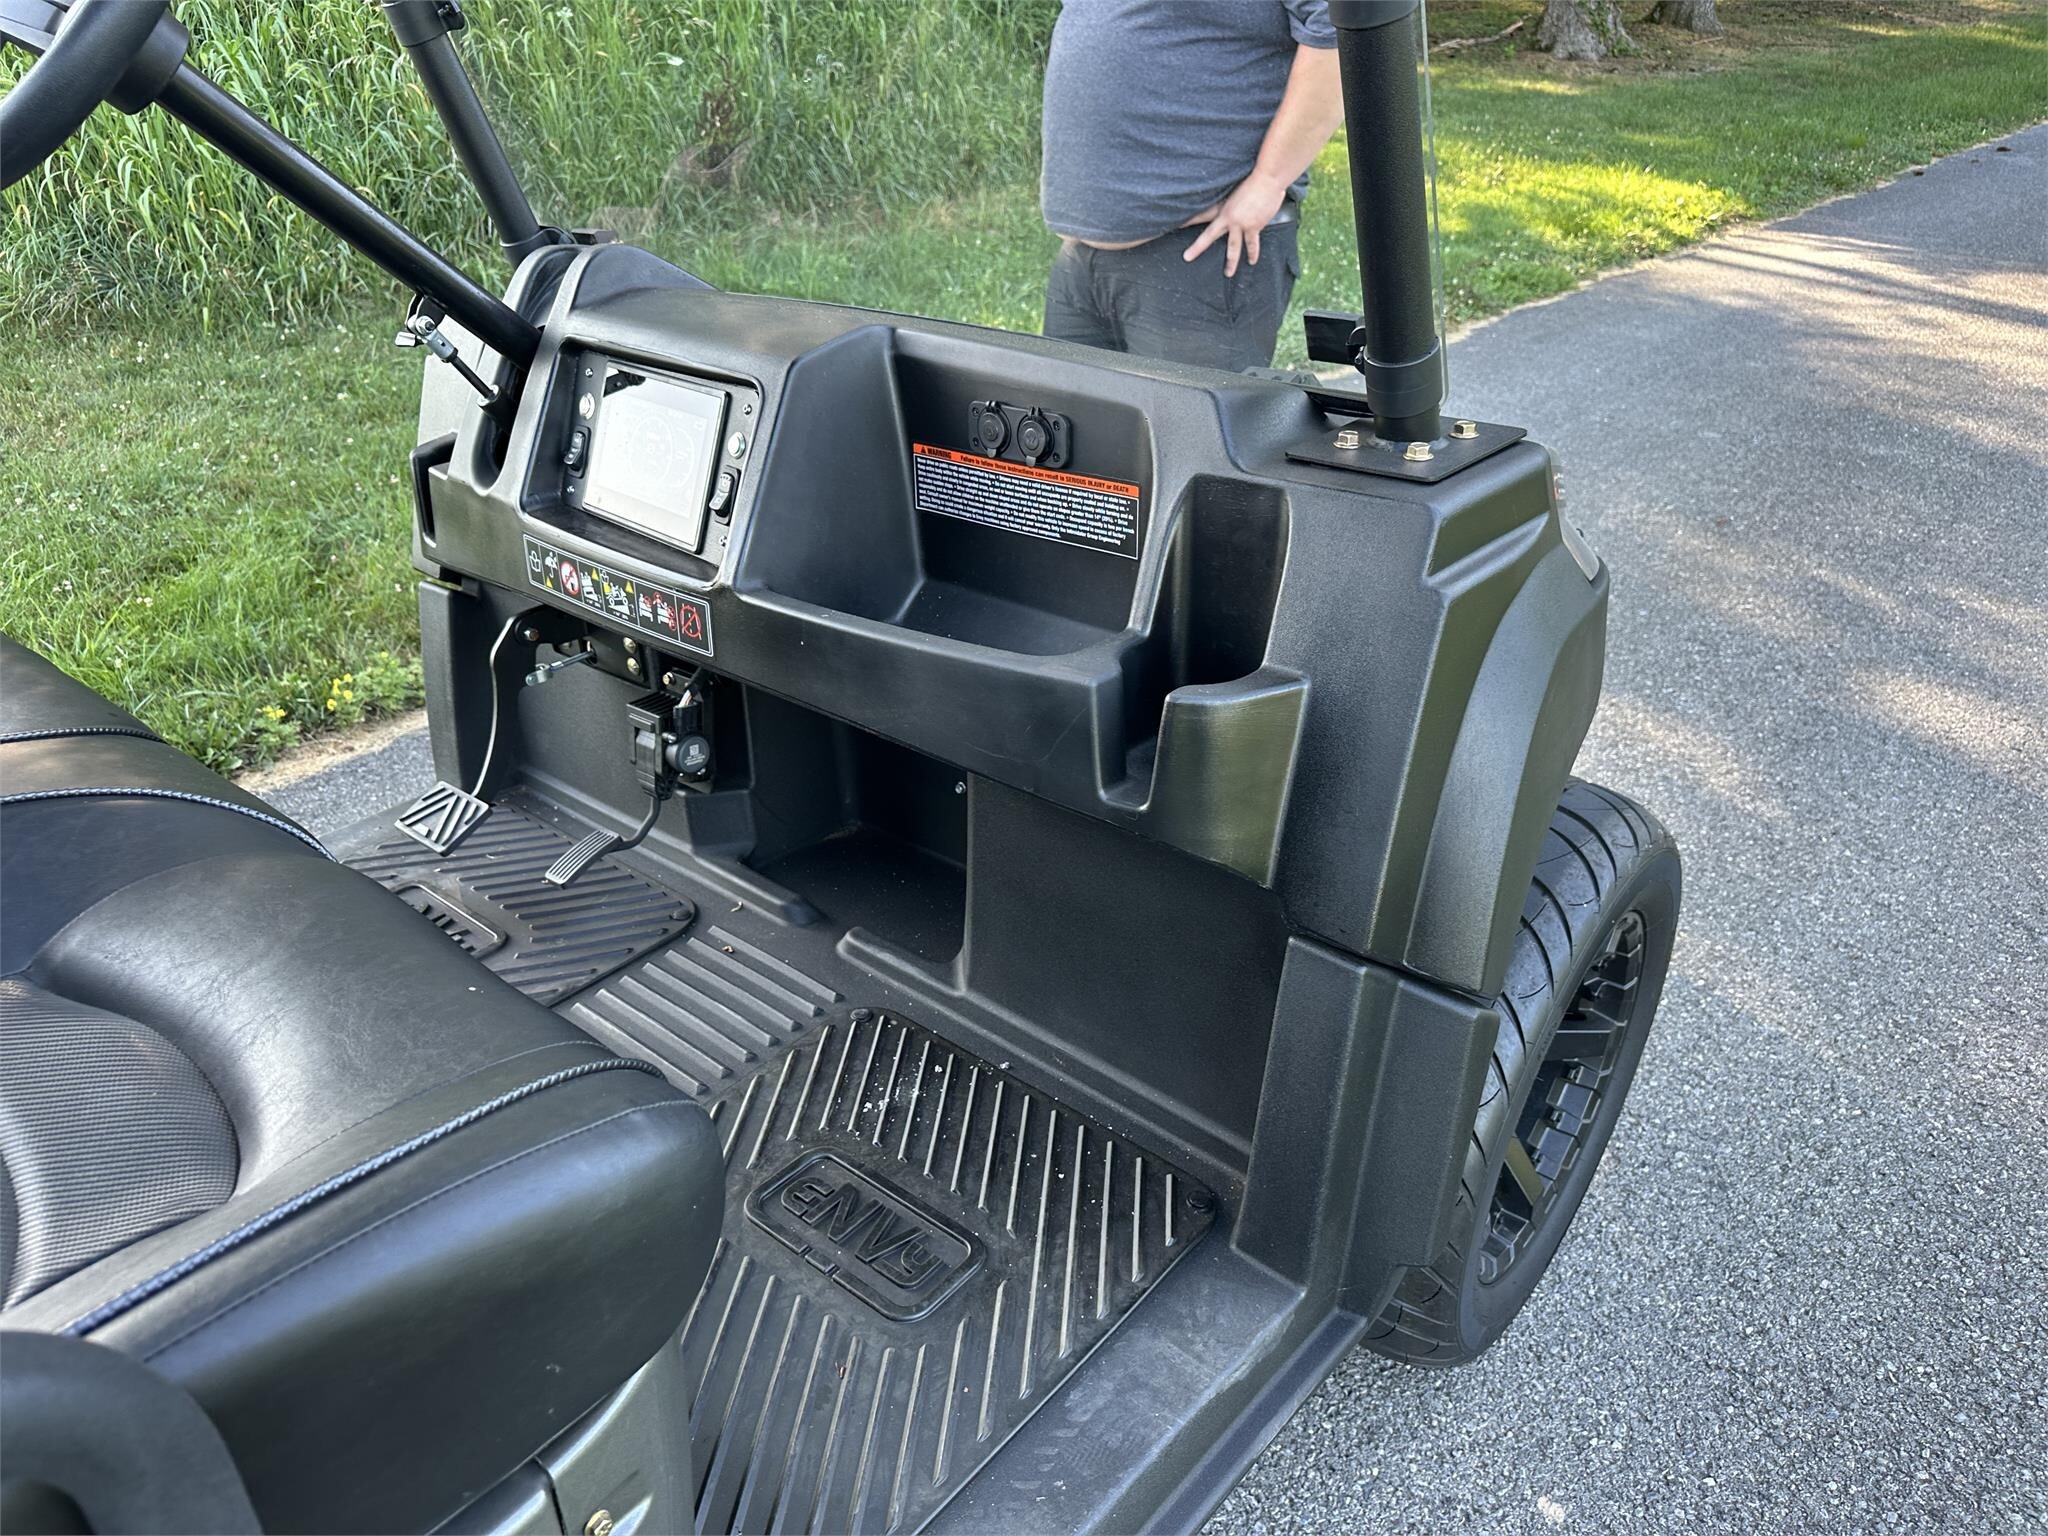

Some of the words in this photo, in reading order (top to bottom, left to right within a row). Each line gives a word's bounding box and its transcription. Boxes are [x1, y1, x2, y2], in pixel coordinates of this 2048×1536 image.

[926, 447, 951, 458] WARNING
[1066, 476, 1085, 485] SERIOUS
[1087, 480, 1104, 488] INJURY
[1112, 484, 1128, 492] DEATH
